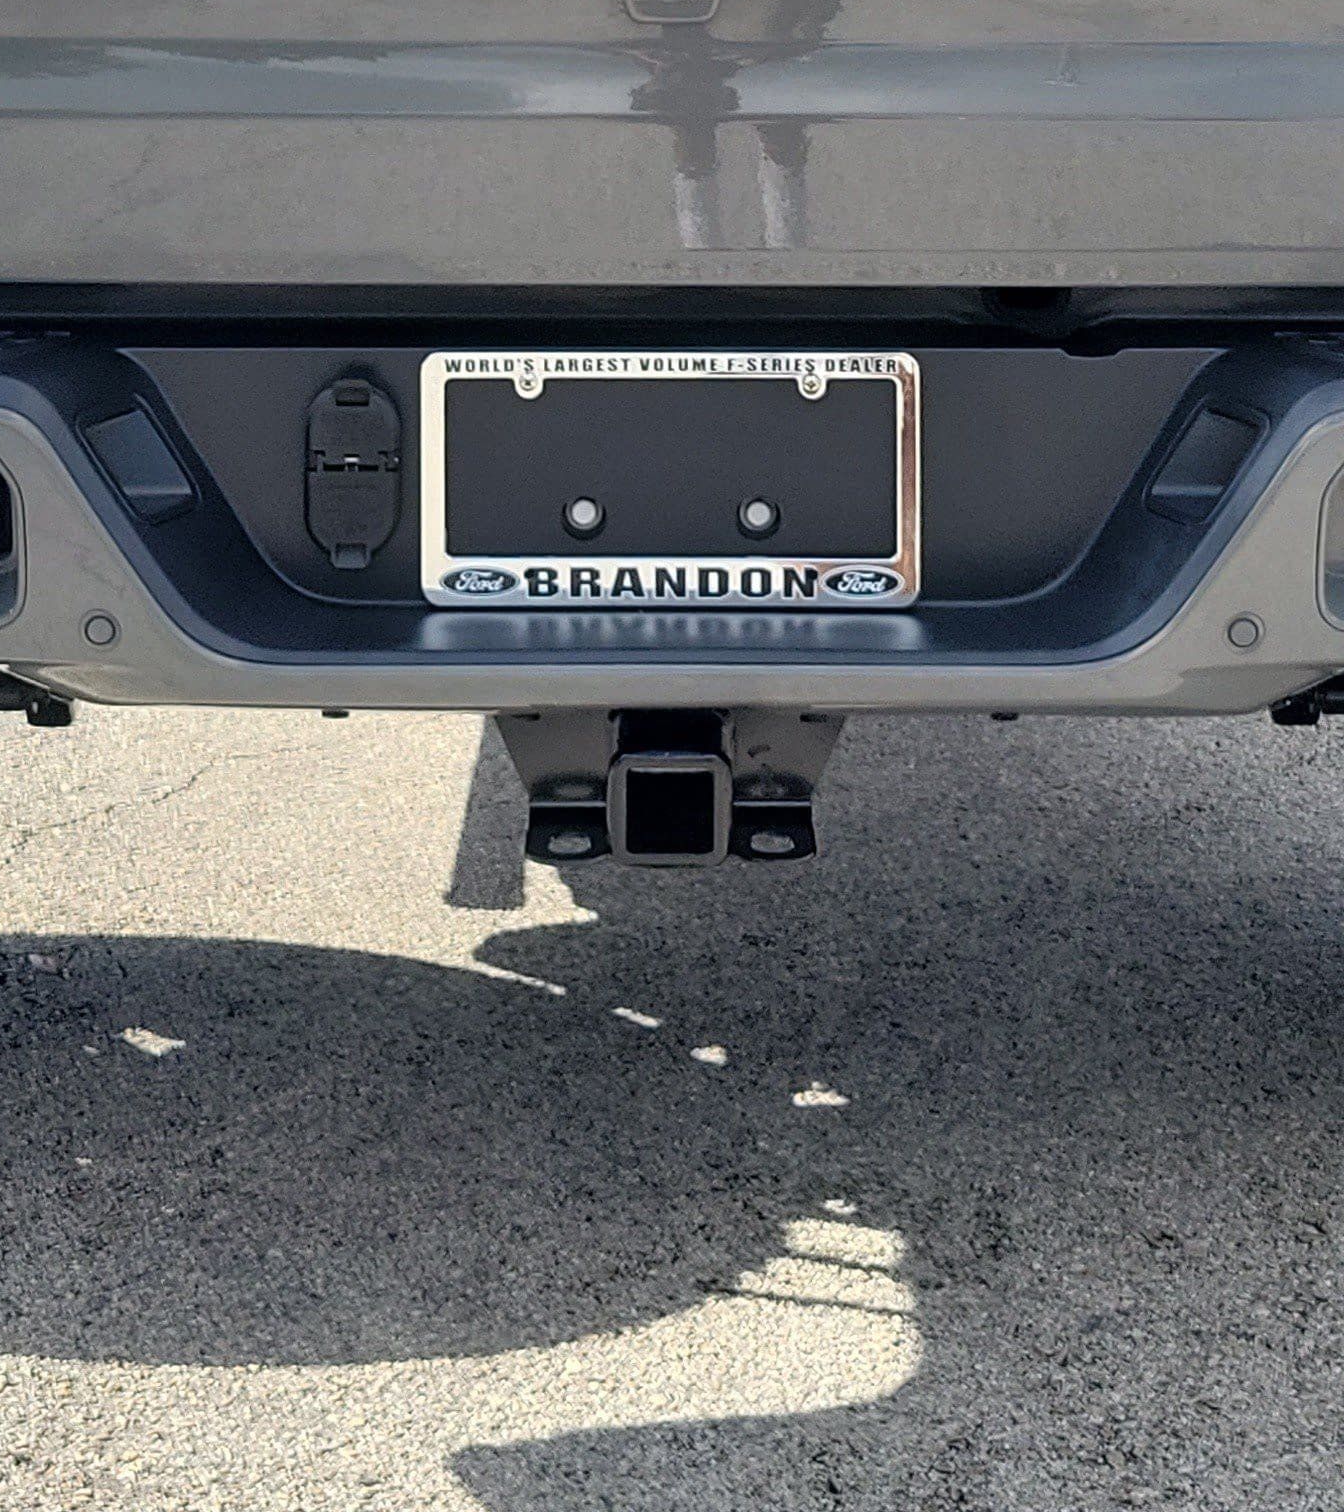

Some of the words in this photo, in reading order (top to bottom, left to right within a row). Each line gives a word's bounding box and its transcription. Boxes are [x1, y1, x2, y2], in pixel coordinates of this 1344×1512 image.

[444, 357, 535, 373] WORLD'S
[543, 358, 631, 373] LARGEST
[638, 358, 718, 373] VOLUME
[727, 358, 816, 373] F-SERIES
[825, 358, 898, 374] DEALER
[456, 569, 505, 592] Ford
[525, 566, 818, 598] BRANDON
[837, 571, 886, 593] Ford
